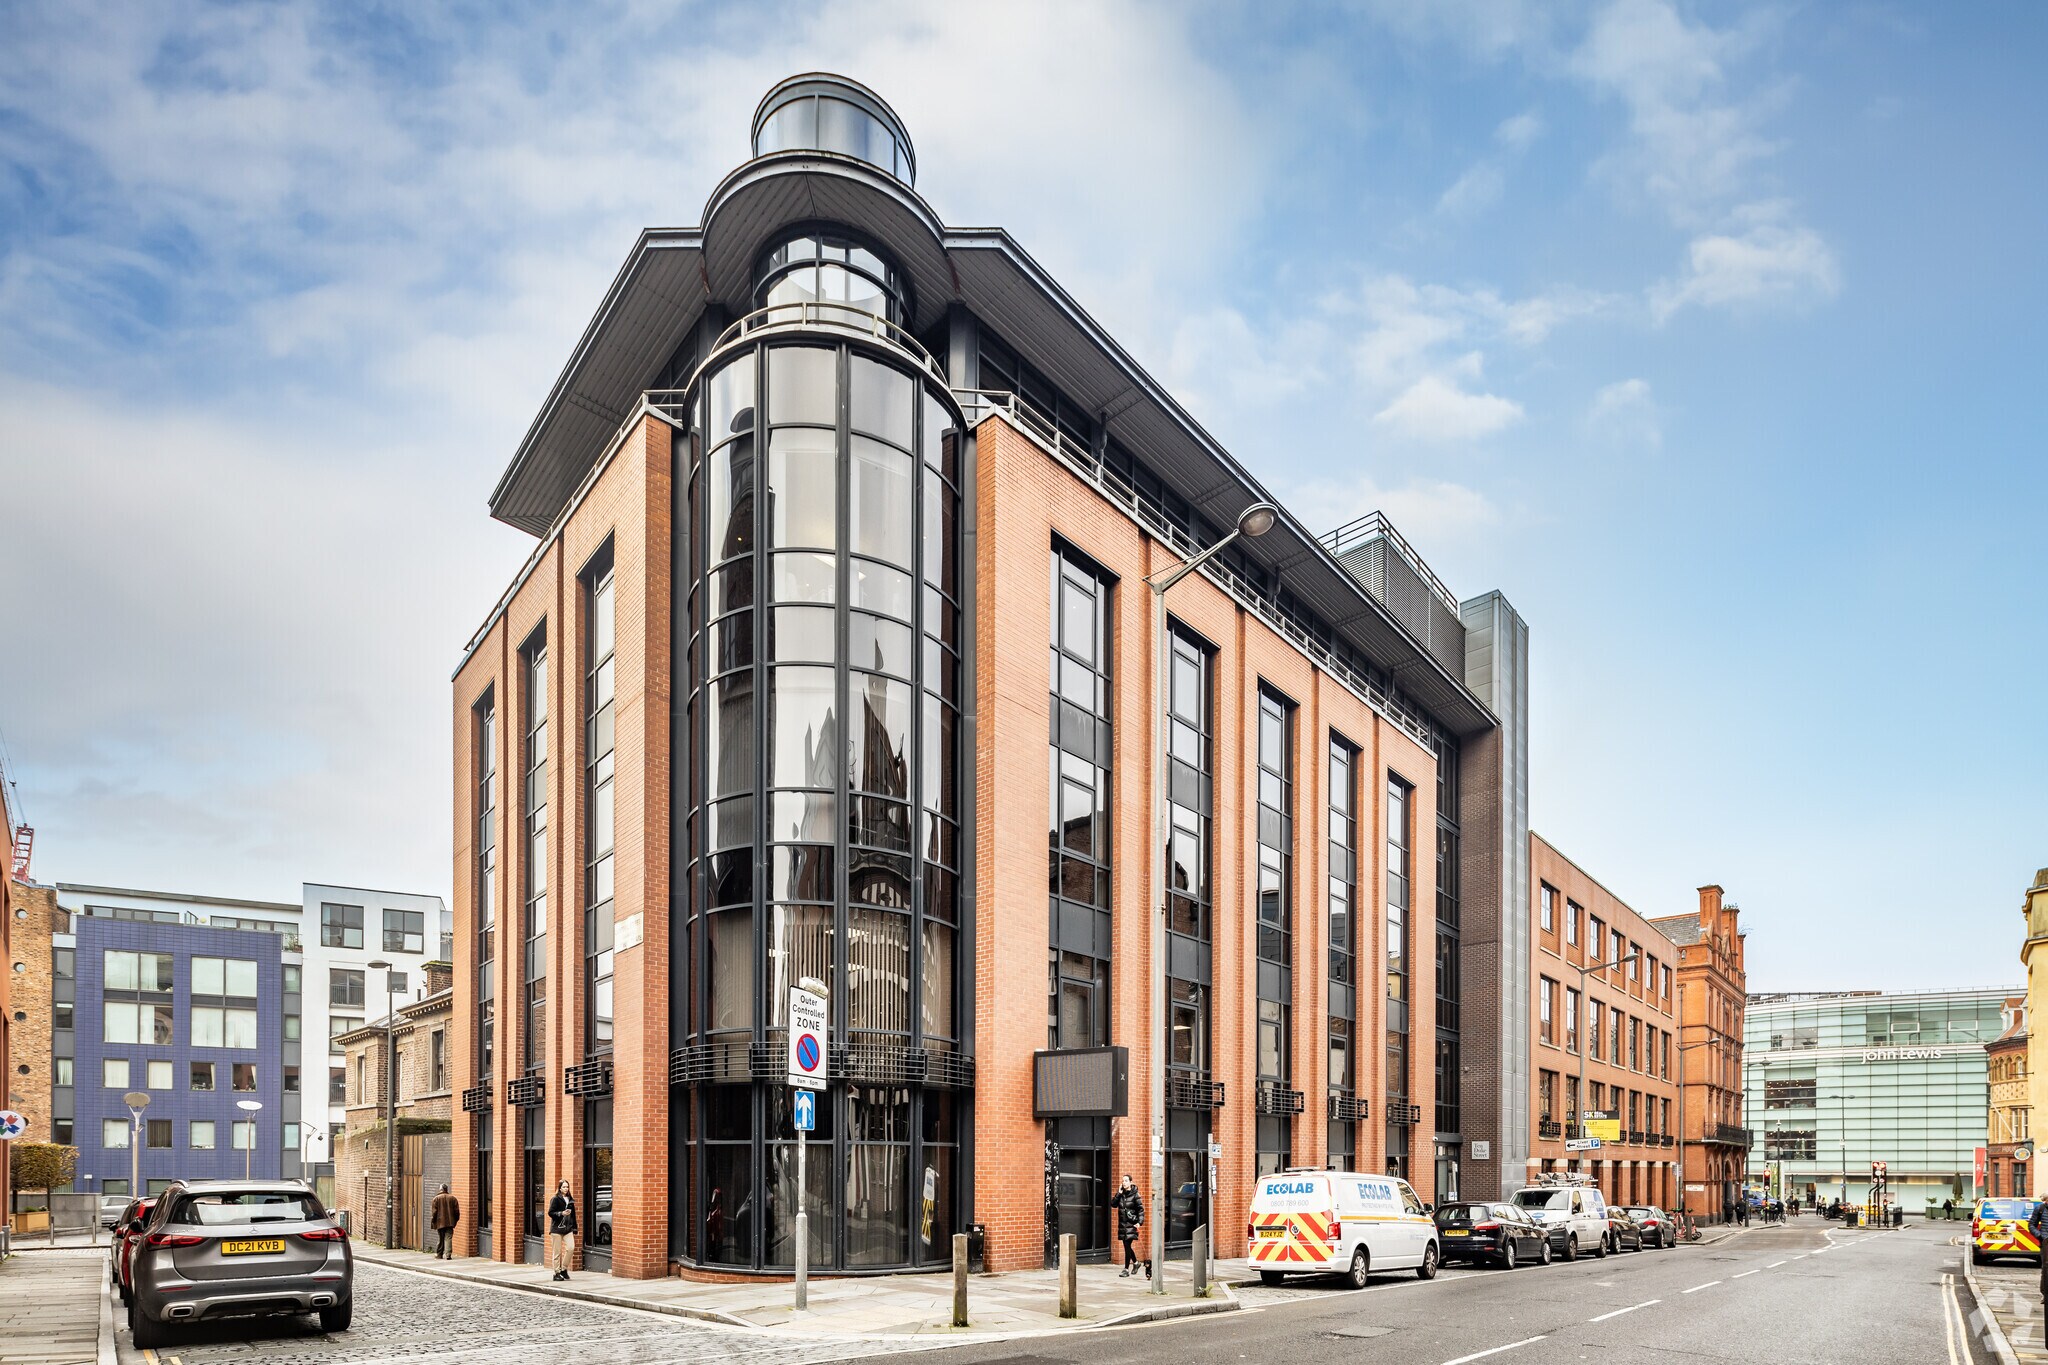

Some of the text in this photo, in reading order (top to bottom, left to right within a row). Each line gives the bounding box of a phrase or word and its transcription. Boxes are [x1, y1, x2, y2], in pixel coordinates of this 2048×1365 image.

[800, 994, 818, 1006] Outer
[792, 1003, 825, 1019] Controlled
[797, 1017, 820, 1031] ZONE
[1861, 1046, 1942, 1064] John Lewis
[1266, 1183, 1314, 1195] ECOLAB
[1357, 1183, 1392, 1200] ECOLAB
[229, 1241, 279, 1252] DC21 KVB
